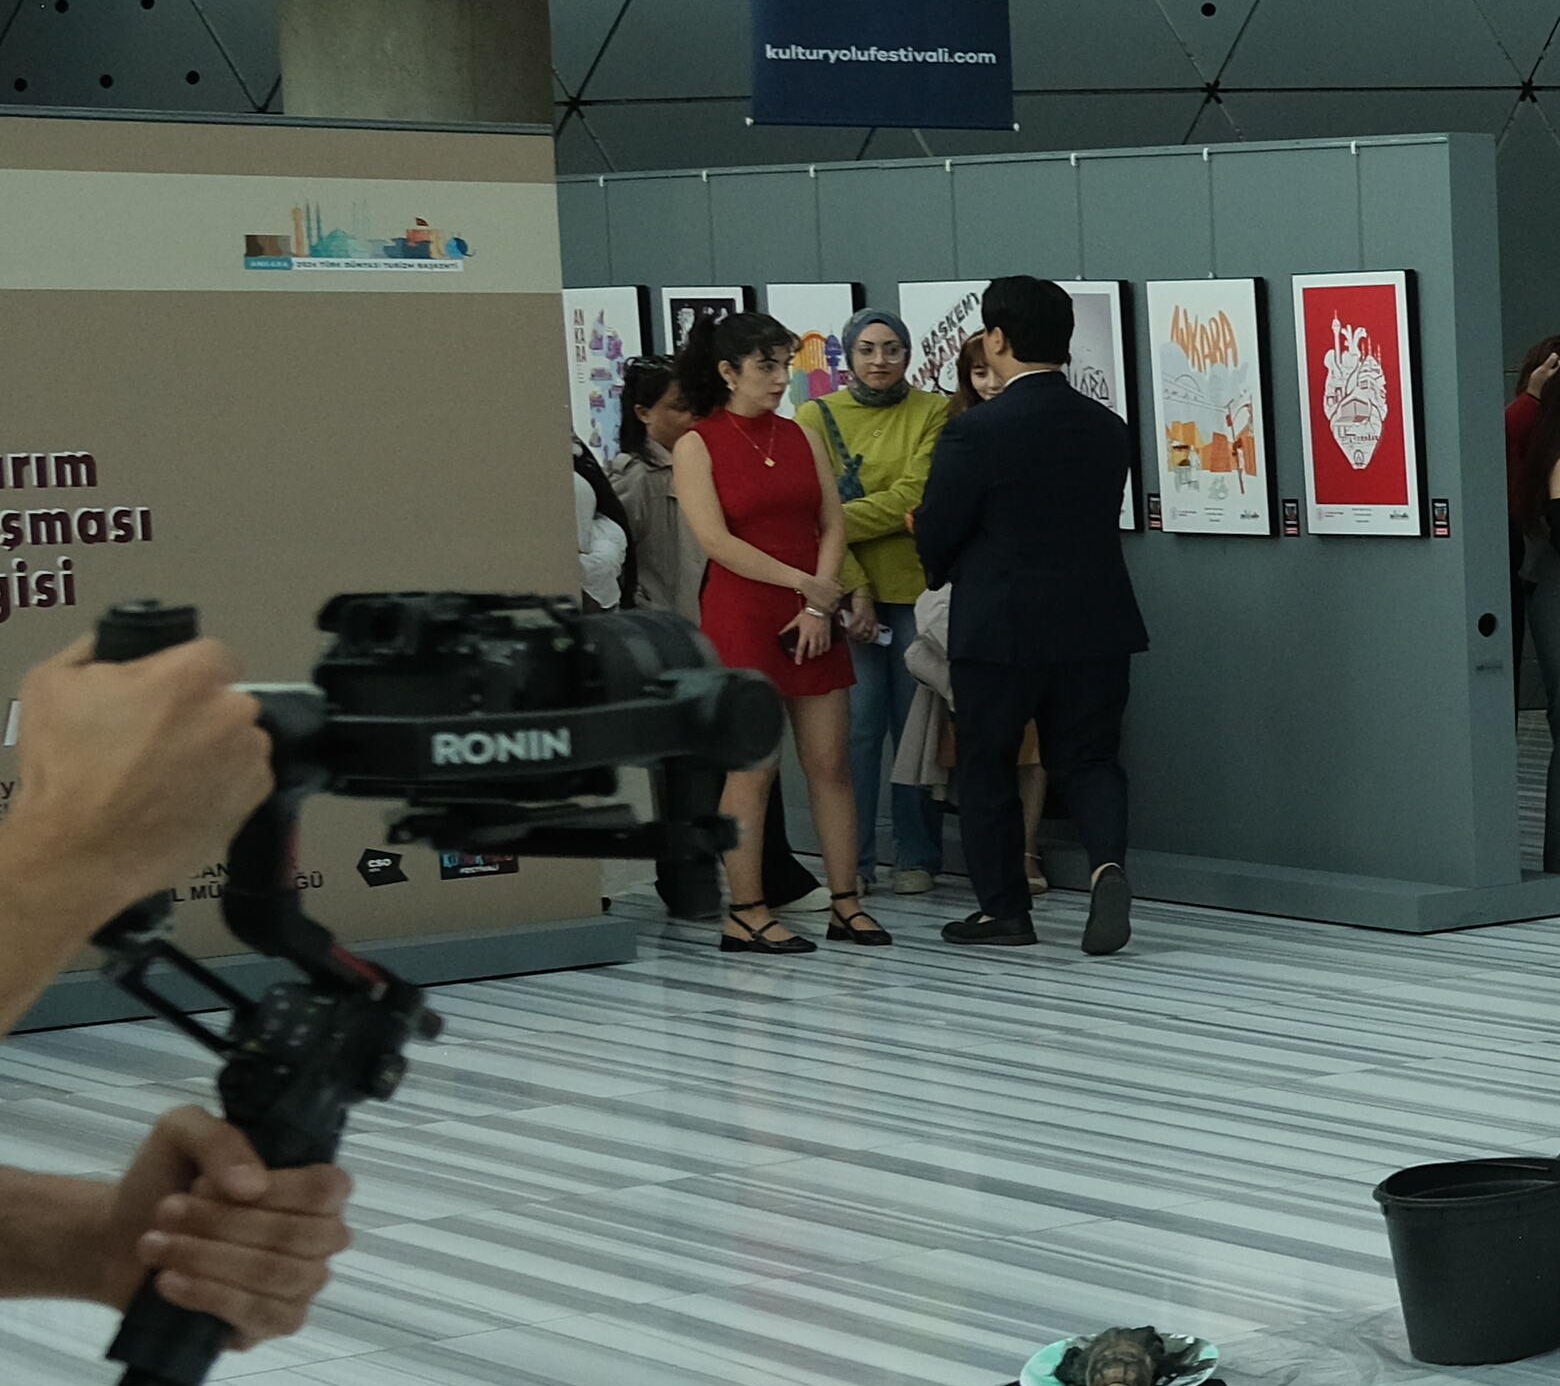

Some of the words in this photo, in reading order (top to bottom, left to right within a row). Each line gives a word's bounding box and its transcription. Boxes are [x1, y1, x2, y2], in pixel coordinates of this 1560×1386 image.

[765, 44, 996, 65] kulturyolufestivali.com
[0, 506, 152, 551] şması
[432, 728, 571, 766] RONIN
